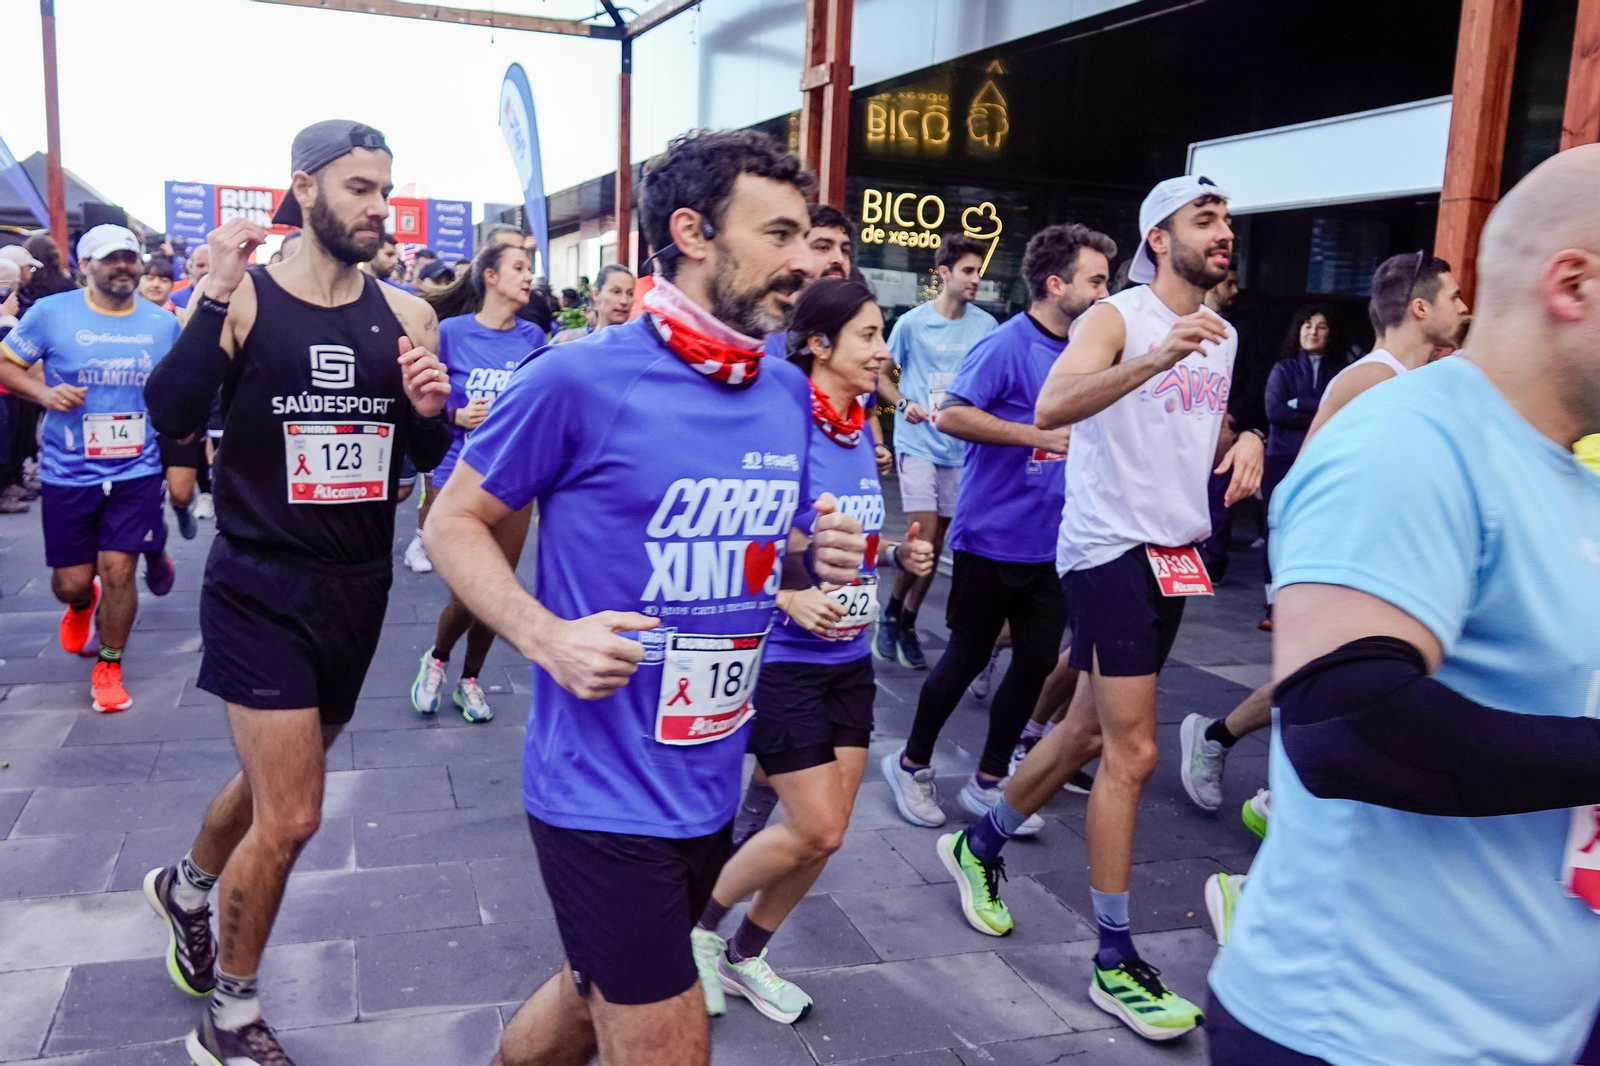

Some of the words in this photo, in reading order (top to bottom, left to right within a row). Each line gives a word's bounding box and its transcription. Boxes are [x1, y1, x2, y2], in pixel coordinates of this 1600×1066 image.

[220, 187, 273, 211] RUN
[861, 188, 945, 229] BICO
[860, 224, 886, 244] de
[887, 229, 942, 249] xeado
[110, 424, 129, 440] 14
[321, 442, 363, 471] 123
[313, 484, 368, 499] Alcampo
[646, 477, 800, 539] CORRER
